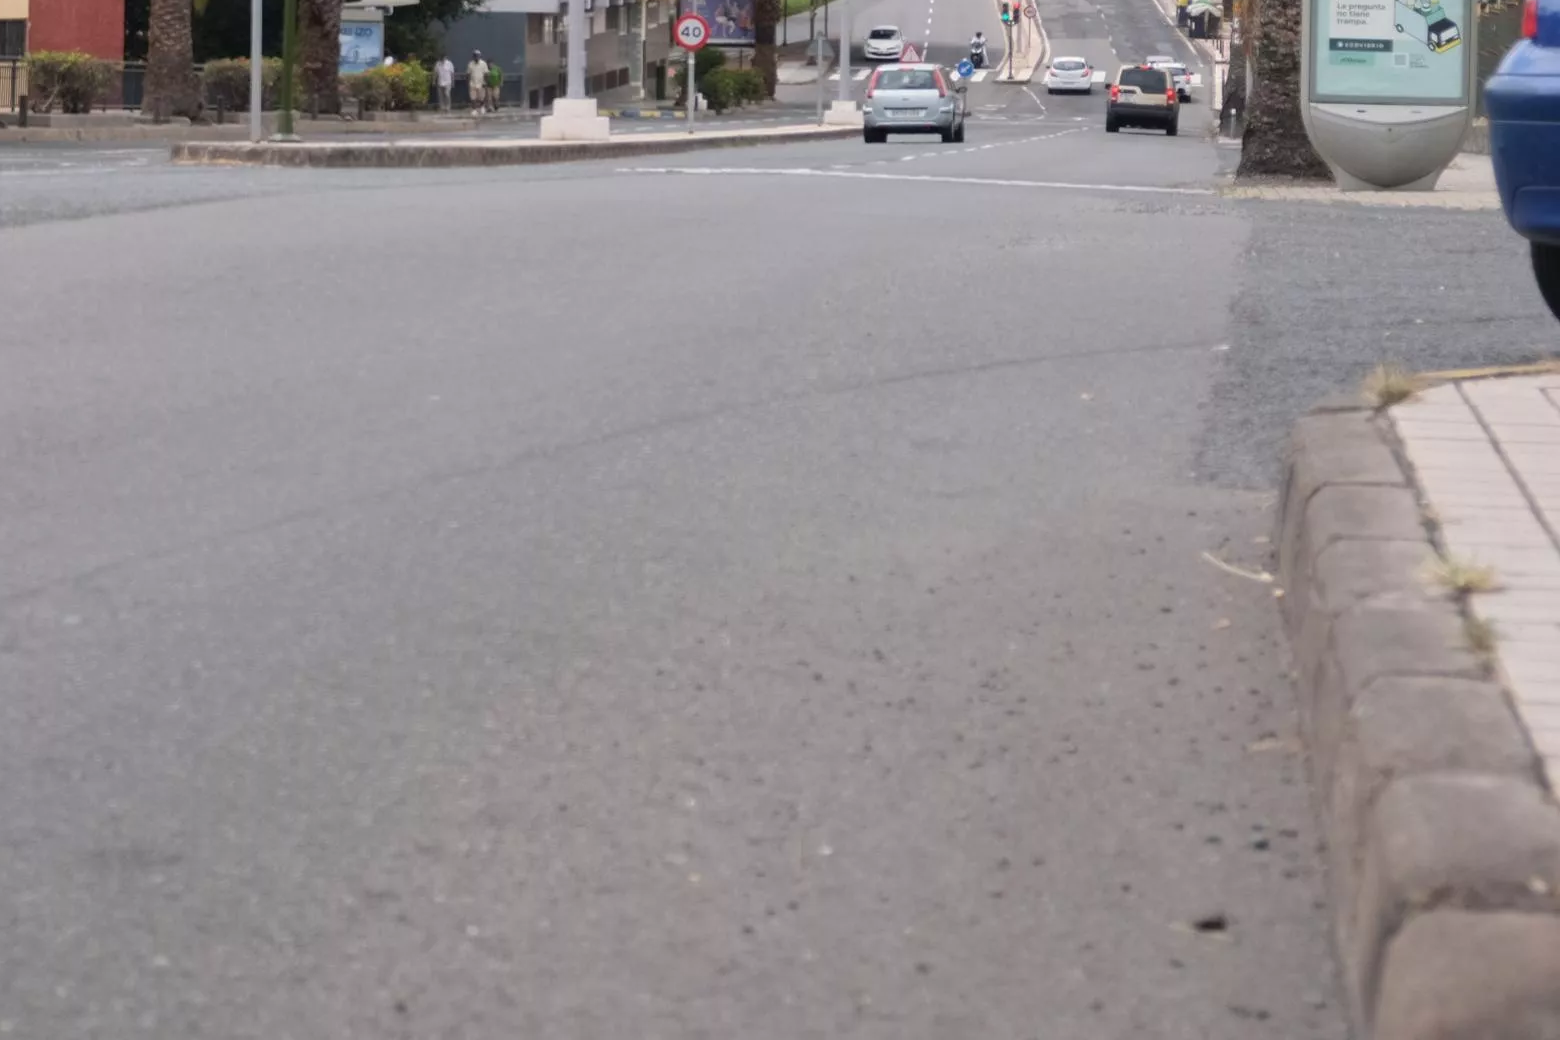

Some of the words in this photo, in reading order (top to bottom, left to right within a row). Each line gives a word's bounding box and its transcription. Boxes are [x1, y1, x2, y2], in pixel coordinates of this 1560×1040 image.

[1351, 3, 1386, 12] pregunta
[1349, 10, 1371, 18] tiene
[681, 26, 702, 38] 40
